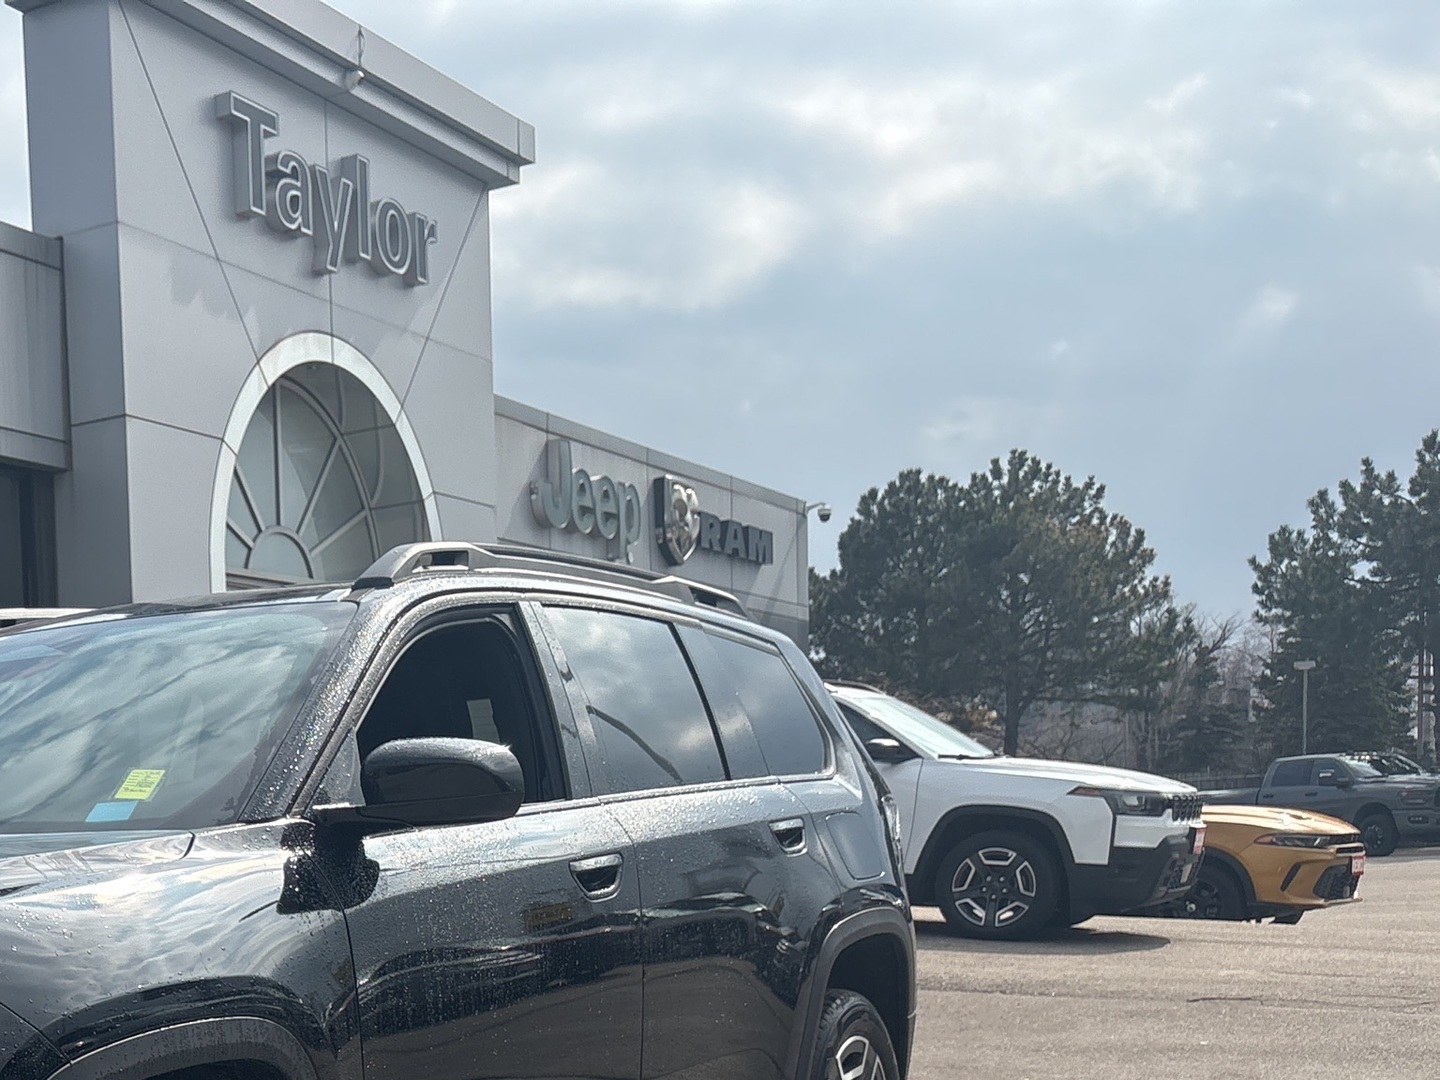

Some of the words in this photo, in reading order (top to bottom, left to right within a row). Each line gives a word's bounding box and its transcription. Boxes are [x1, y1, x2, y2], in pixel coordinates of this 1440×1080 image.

[220, 90, 438, 284] Taylor
[532, 439, 642, 562] Jeep
[699, 511, 774, 565] RAM
